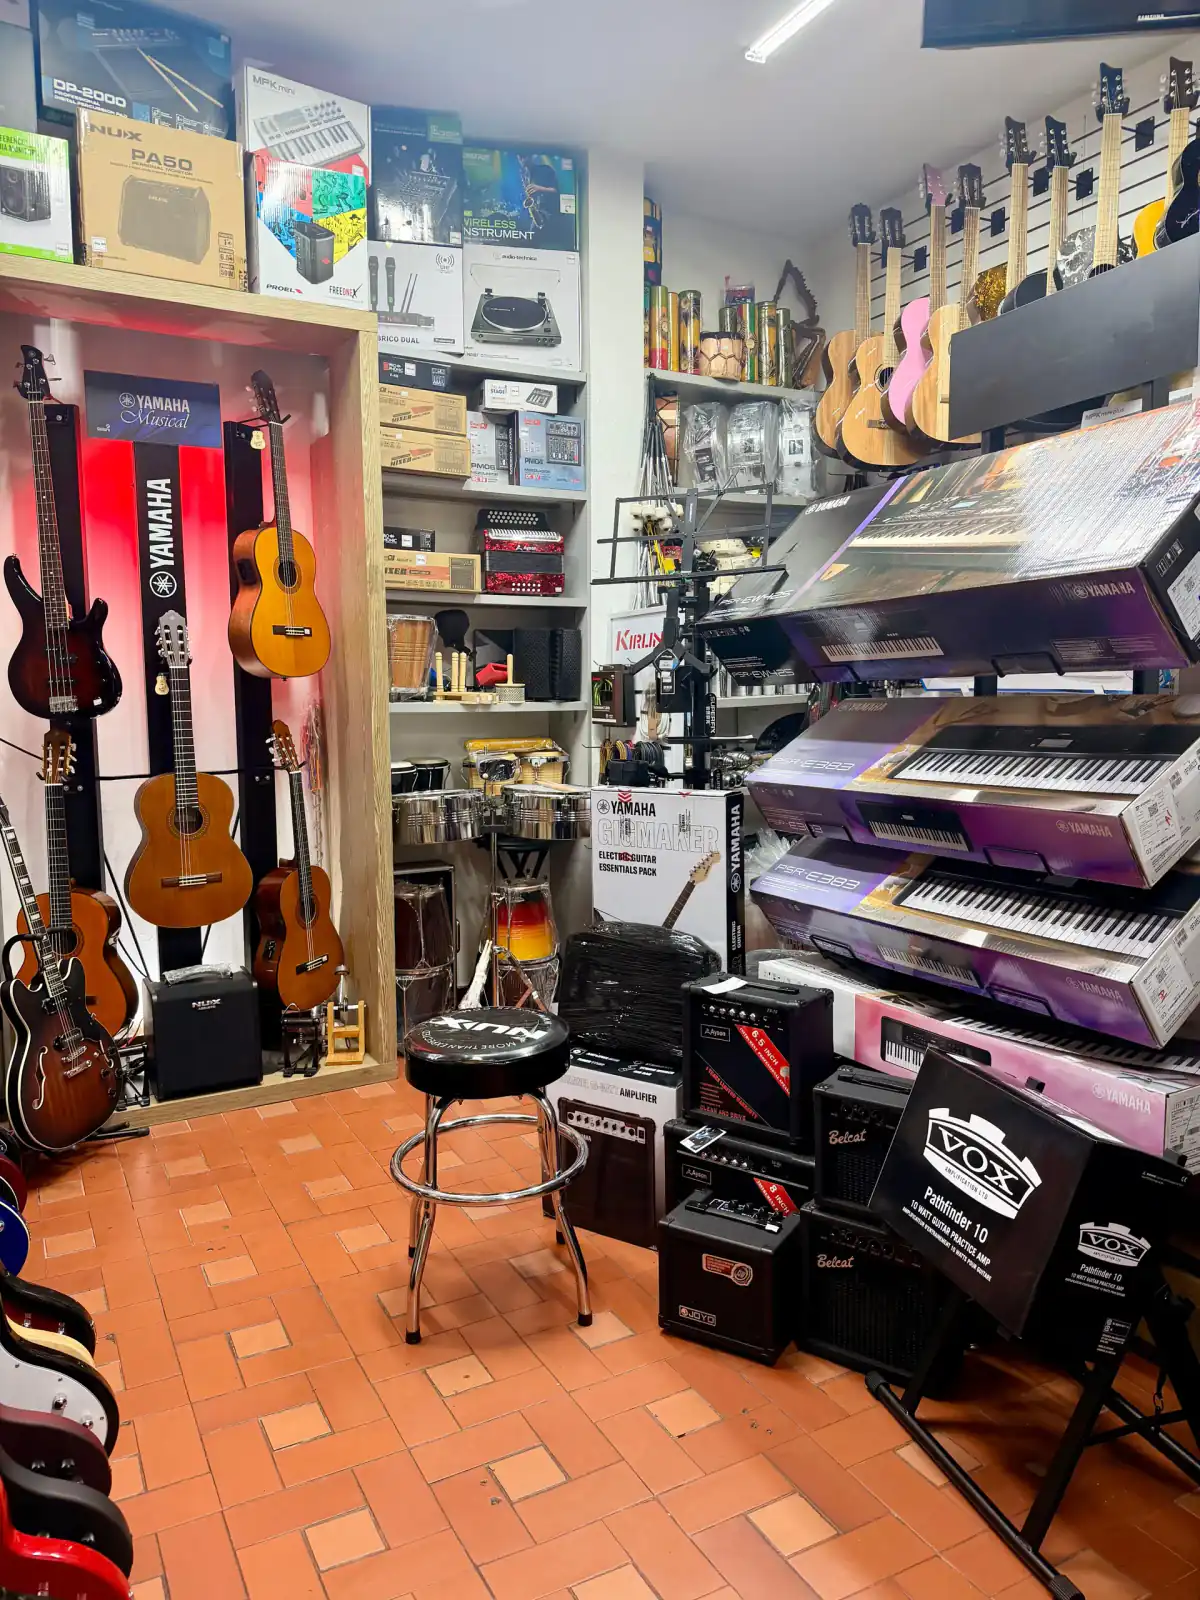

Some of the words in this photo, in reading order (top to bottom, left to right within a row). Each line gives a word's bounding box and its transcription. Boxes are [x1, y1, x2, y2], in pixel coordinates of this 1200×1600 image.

[53, 78, 127, 108] DP-2000
[252, 75, 277, 89] MPK
[278, 84, 296, 96] mini
[131, 148, 193, 171] PA50
[463, 227, 536, 240] NSTRUMENT
[266, 283, 295, 294] PROEL
[400, 336, 420, 344] DUAL
[137, 394, 190, 413] YAMAHA
[120, 409, 190, 429] Musical
[146, 478, 175, 569] YAMAHA
[1087, 581, 1136, 597] YAMAHA
[615, 629, 665, 652] KIRLIN
[731, 668, 795, 678] PSR-EW425
[611, 801, 657, 817] YAMAHA
[597, 817, 720, 853] GIGMAKER
[731, 804, 741, 872] YAMAHA
[1068, 820, 1113, 837] YAMAHA
[631, 852, 657, 864] GUITAR
[599, 863, 638, 875] ESSENTIALS
[638, 864, 657, 877] PACK
[775, 863, 861, 890] PSR-E383
[1077, 979, 1124, 1002] YAMAHA
[708, 1027, 726, 1037] Ayson
[480, 1041, 517, 1050] MORE
[751, 1029, 766, 1048] 6.5
[763, 1047, 779, 1066] INCH
[619, 1087, 658, 1105] AMPLIFIER
[1105, 1087, 1151, 1115] YAMAHA
[828, 1128, 868, 1145] Belcat
[938, 1126, 1019, 1196] VOX
[944, 1165, 978, 1194] AMPLIFICATION
[978, 1189, 989, 1200] LTD
[769, 1184, 778, 1193] 8
[774, 1194, 790, 1214] INCH
[923, 1185, 973, 1231] Pathfinder
[973, 1223, 989, 1244] 10
[910, 1199, 919, 1210] 10
[917, 1204, 933, 1221] WATT
[931, 1216, 951, 1236] GUITAR
[949, 1230, 978, 1257] PRACTICE
[976, 1251, 991, 1267] AMP
[1087, 1232, 1139, 1257] VOX
[816, 1253, 855, 1268] Belcat
[1079, 1263, 1113, 1279] Pathfinder
[1112, 1273, 1123, 1282] 10
[688, 1311, 715, 1324] JOYO
